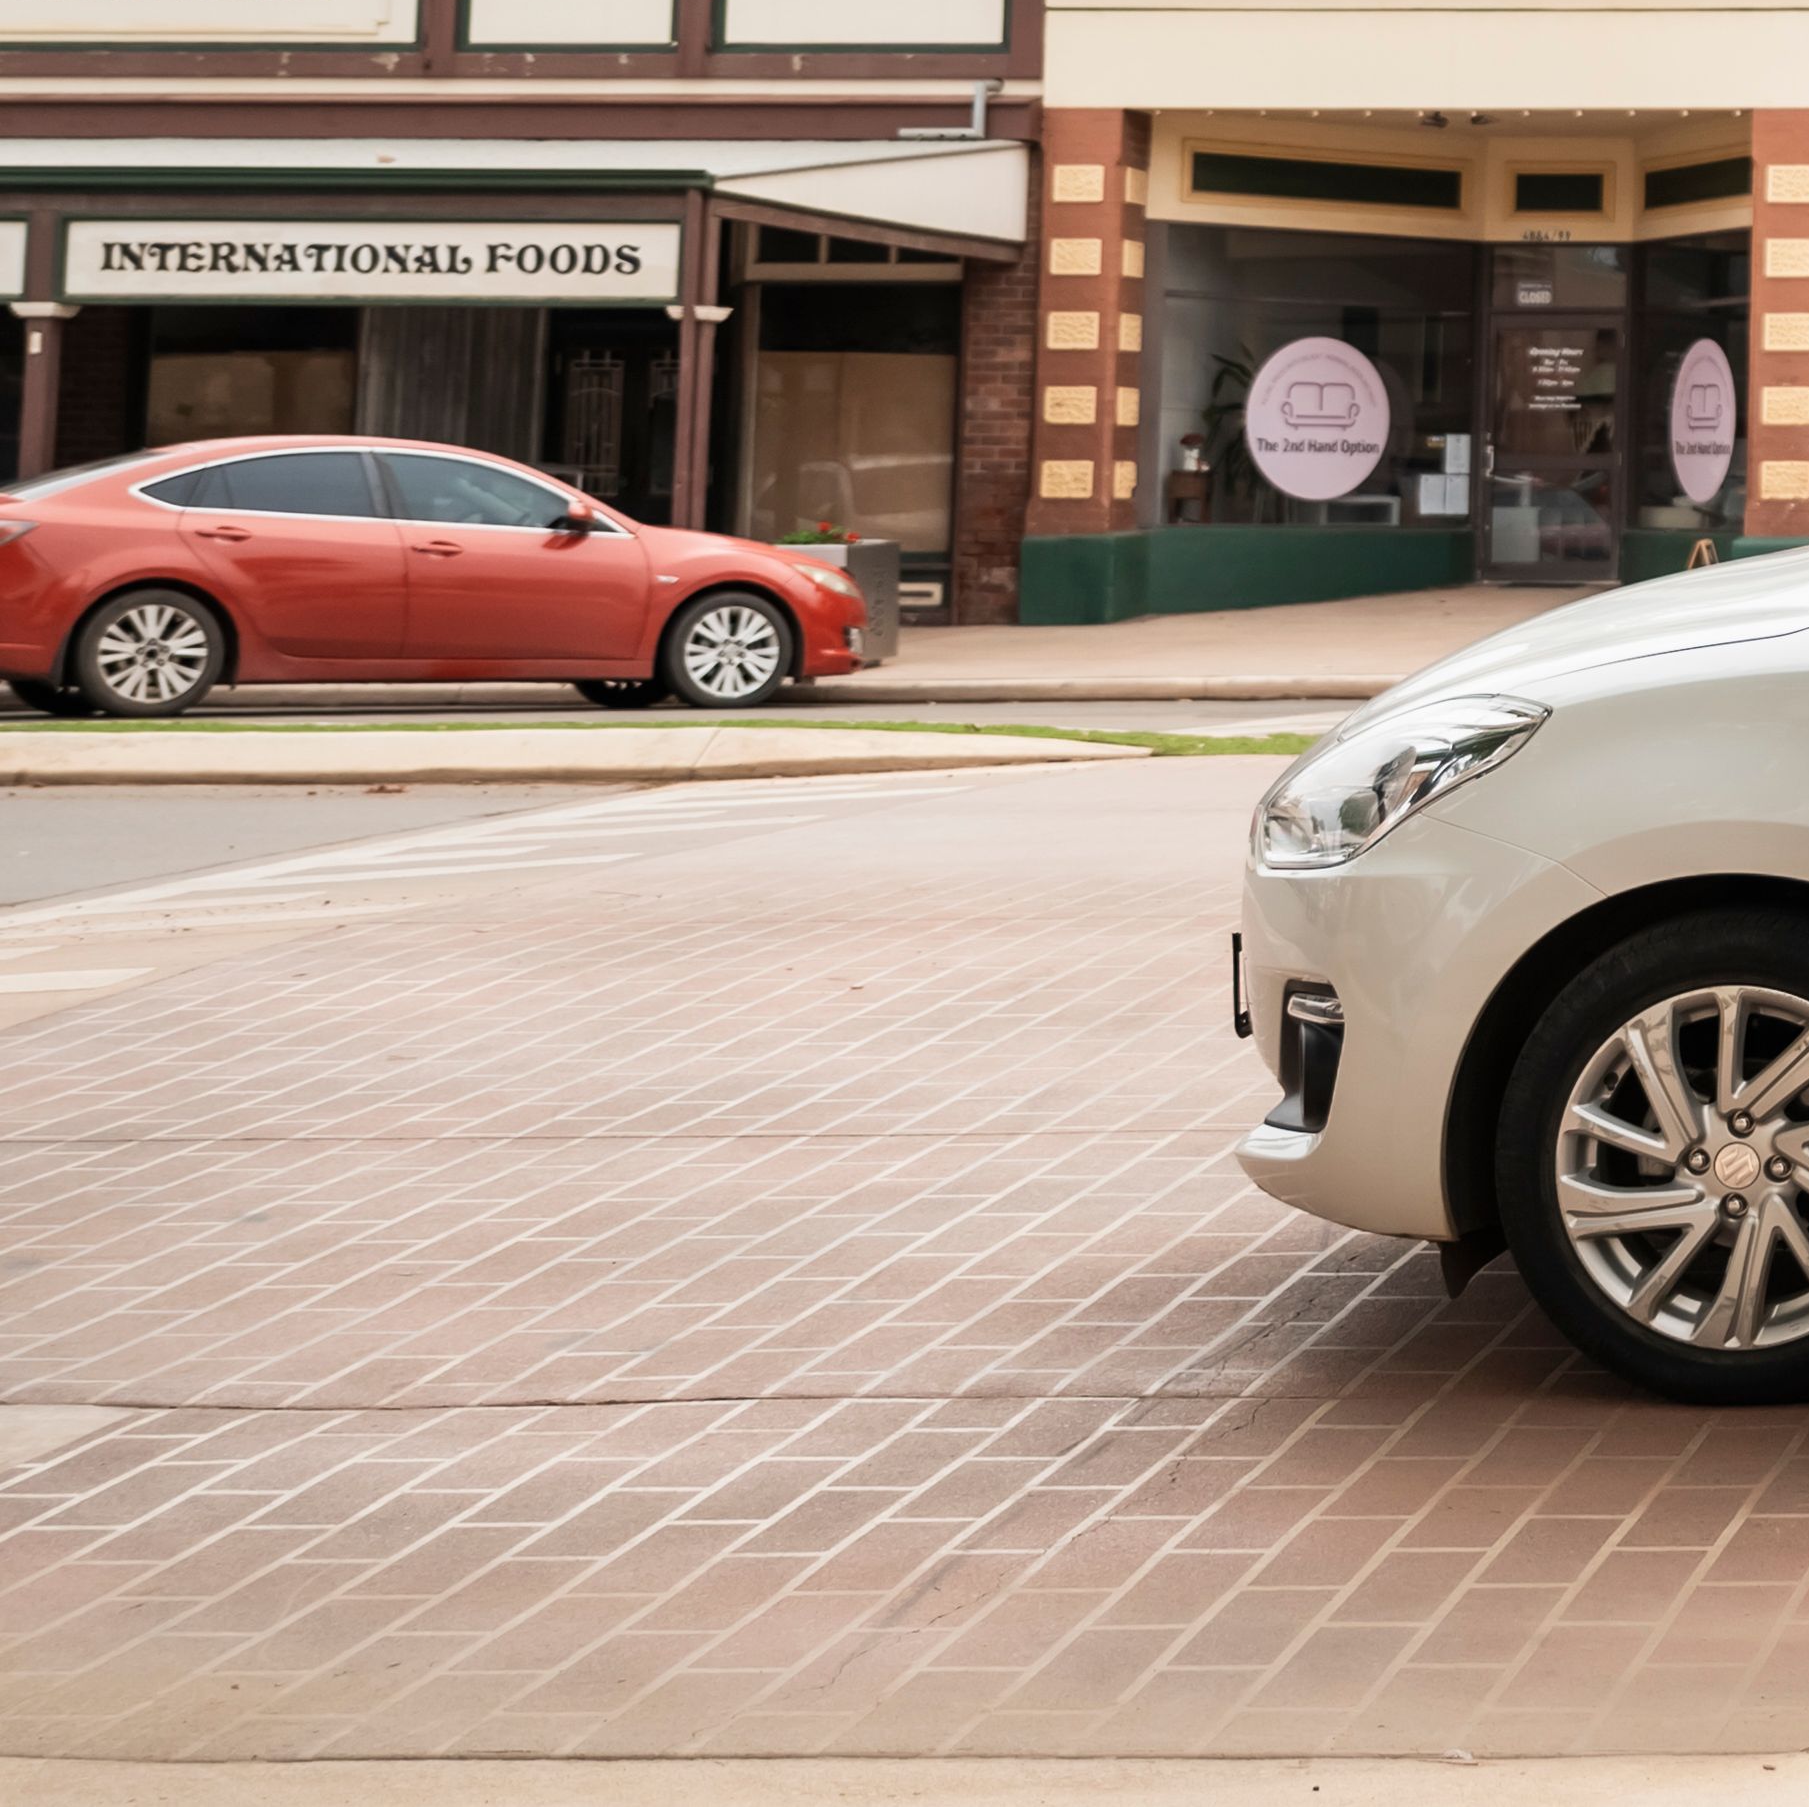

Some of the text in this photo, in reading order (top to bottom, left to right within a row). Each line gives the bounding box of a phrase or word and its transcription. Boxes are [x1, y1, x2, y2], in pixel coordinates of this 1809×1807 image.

[100, 240, 643, 276] INTERNATIONAL FOODS
[1257, 437, 1380, 456] The 2nd Hand Option
